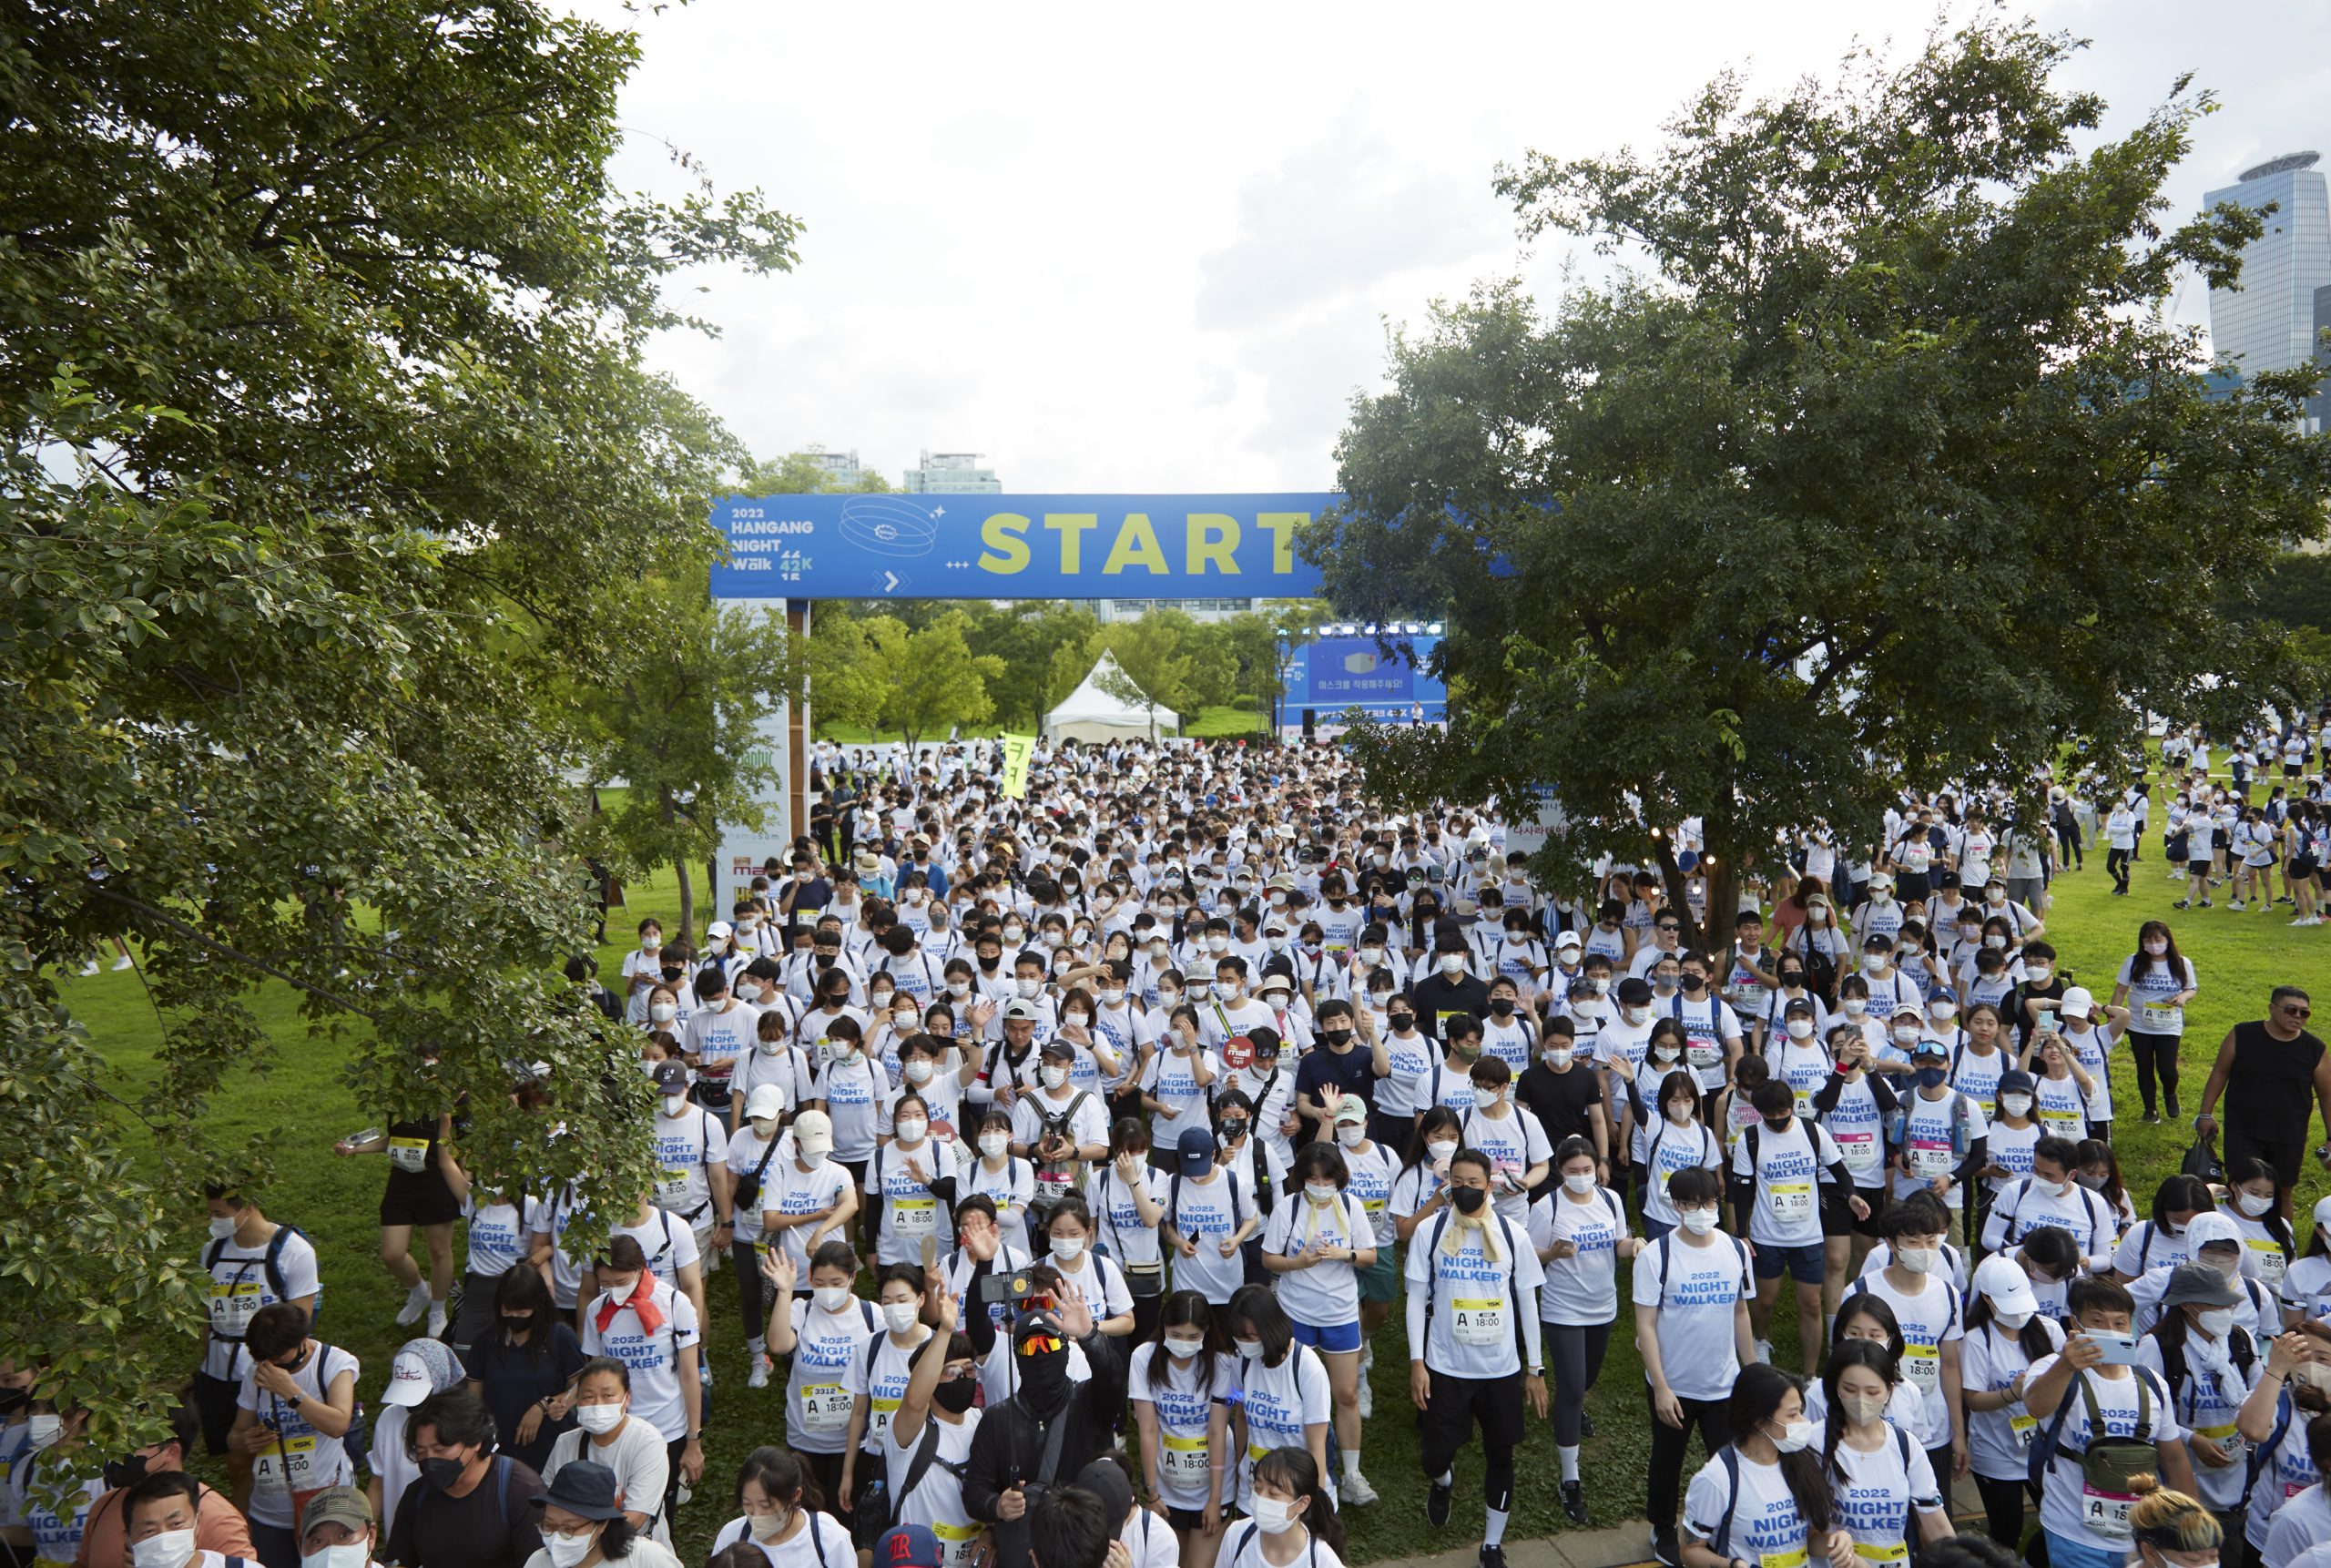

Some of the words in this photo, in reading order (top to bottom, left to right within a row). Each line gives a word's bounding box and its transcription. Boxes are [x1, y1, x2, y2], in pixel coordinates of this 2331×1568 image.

[732, 508, 764, 518] 2022
[732, 521, 814, 534] HANGANG
[732, 539, 781, 552] NIGHT
[977, 513, 1309, 575] START
[2145, 1010, 2153, 1018] A
[820, 1047, 829, 1056] A
[1227, 1049, 1250, 1057] mall
[1490, 1048, 1523, 1056] NIGHT
[1161, 1079, 1196, 1088] NIGHT
[830, 1088, 864, 1096] NIGHT
[1798, 1101, 1806, 1110] A
[1836, 1105, 1873, 1113] NIGHT
[1830, 1113, 1878, 1122] WALKER
[2057, 1124, 2076, 1132] 18:00
[391, 1148, 398, 1158] A
[1911, 1151, 1919, 1162] A
[1927, 1156, 1948, 1164] 18:00
[1767, 1158, 1811, 1170] NIGHT
[667, 1186, 687, 1194] 18:00
[1037, 1184, 1044, 1195] A
[1775, 1196, 1784, 1207] A
[896, 1210, 905, 1224] A
[911, 1215, 932, 1223] 18:00
[1179, 1214, 1224, 1222] NIGHT
[1439, 1268, 1501, 1282] WALKER
[1691, 1271, 1719, 1279] 2022
[1681, 1281, 1730, 1292] NIGHT
[215, 1300, 224, 1313] A
[231, 1301, 257, 1311] 18:00
[1457, 1313, 1468, 1326] A
[1475, 1318, 1499, 1326] 18:00
[612, 1336, 644, 1344] 2022
[606, 1345, 656, 1357] NIGHT
[1909, 1366, 1935, 1375] 18:00
[1162, 1393, 1195, 1402] 2022
[1252, 1390, 1279, 1404] 2022
[808, 1400, 818, 1413] A
[826, 1401, 852, 1411] 18:00
[2100, 1410, 2138, 1418] 2022
[877, 1414, 886, 1428] A
[2023, 1431, 2031, 1443] A
[1166, 1452, 1176, 1467] A
[1184, 1459, 1209, 1468] 18:00
[259, 1460, 270, 1476] A
[1850, 1489, 1889, 1497] 2022
[2092, 1502, 2102, 1516] A
